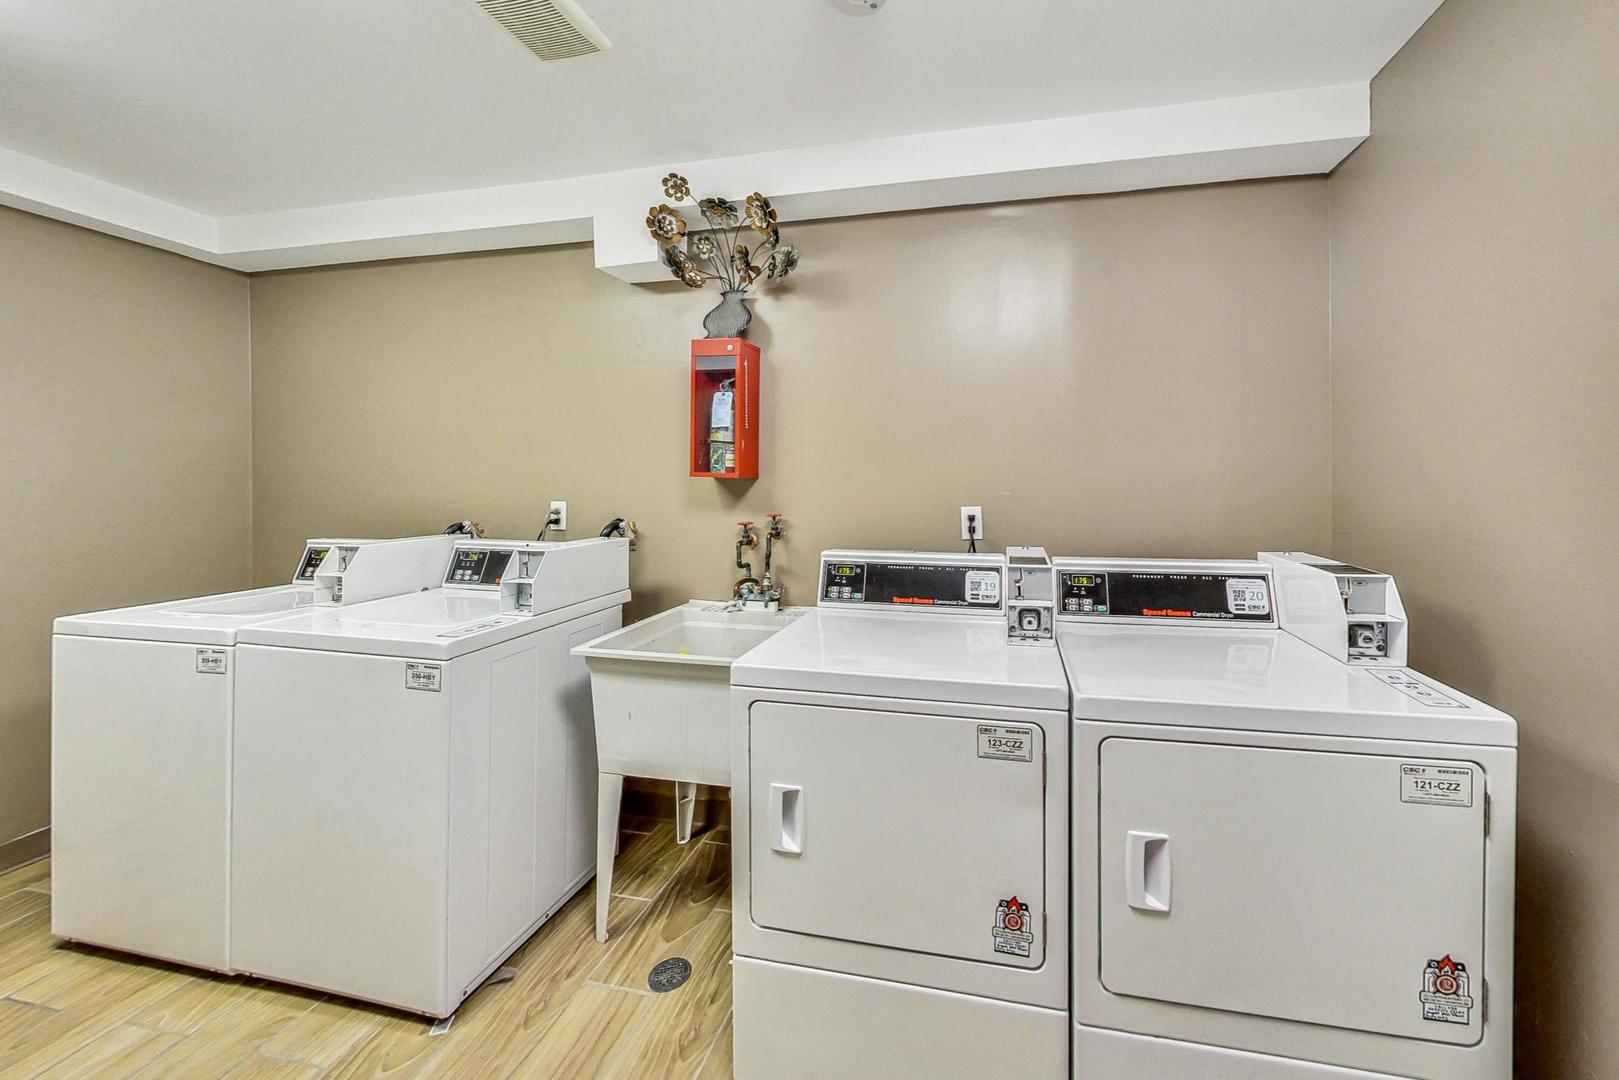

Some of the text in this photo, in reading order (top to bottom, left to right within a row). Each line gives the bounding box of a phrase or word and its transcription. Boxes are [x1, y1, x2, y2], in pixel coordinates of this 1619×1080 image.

[984, 582, 996, 591] 19
[1249, 591, 1264, 601] 20
[1143, 608, 1167, 616] Speed
[988, 738, 1024, 749] 123-CZZ
[1413, 780, 1461, 792] 121-CZZ
